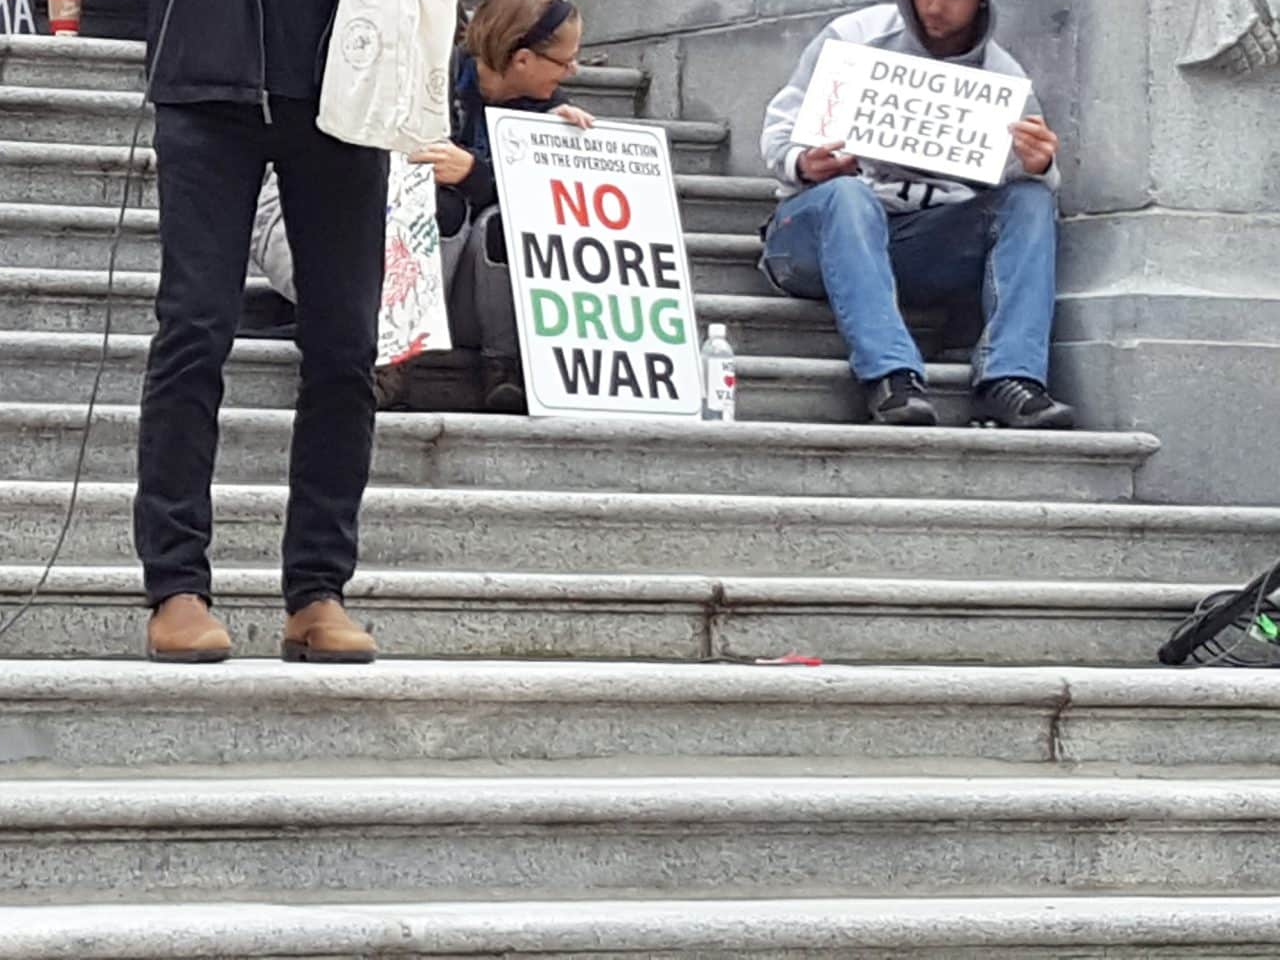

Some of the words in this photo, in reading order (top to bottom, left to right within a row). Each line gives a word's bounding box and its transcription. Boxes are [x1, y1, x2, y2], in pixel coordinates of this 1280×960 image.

[859, 88, 973, 124] RACIST
[869, 61, 946, 94] DRUG
[954, 76, 1013, 107] WAR
[530, 133, 582, 151] NATIONAL
[584, 138, 603, 152] DAY
[606, 141, 618, 154] OF
[621, 143, 659, 158] ACTION
[846, 125, 985, 167] MURDER
[853, 107, 993, 150] HATEFUL
[533, 152, 548, 165] ON
[551, 153, 571, 168] THE
[573, 155, 626, 173] OVERDOSE
[628, 161, 661, 176] CRISIS
[550, 179, 632, 231] NO
[521, 231, 681, 290] MORE
[529, 288, 688, 345] DRUG
[552, 346, 680, 401] WAR
